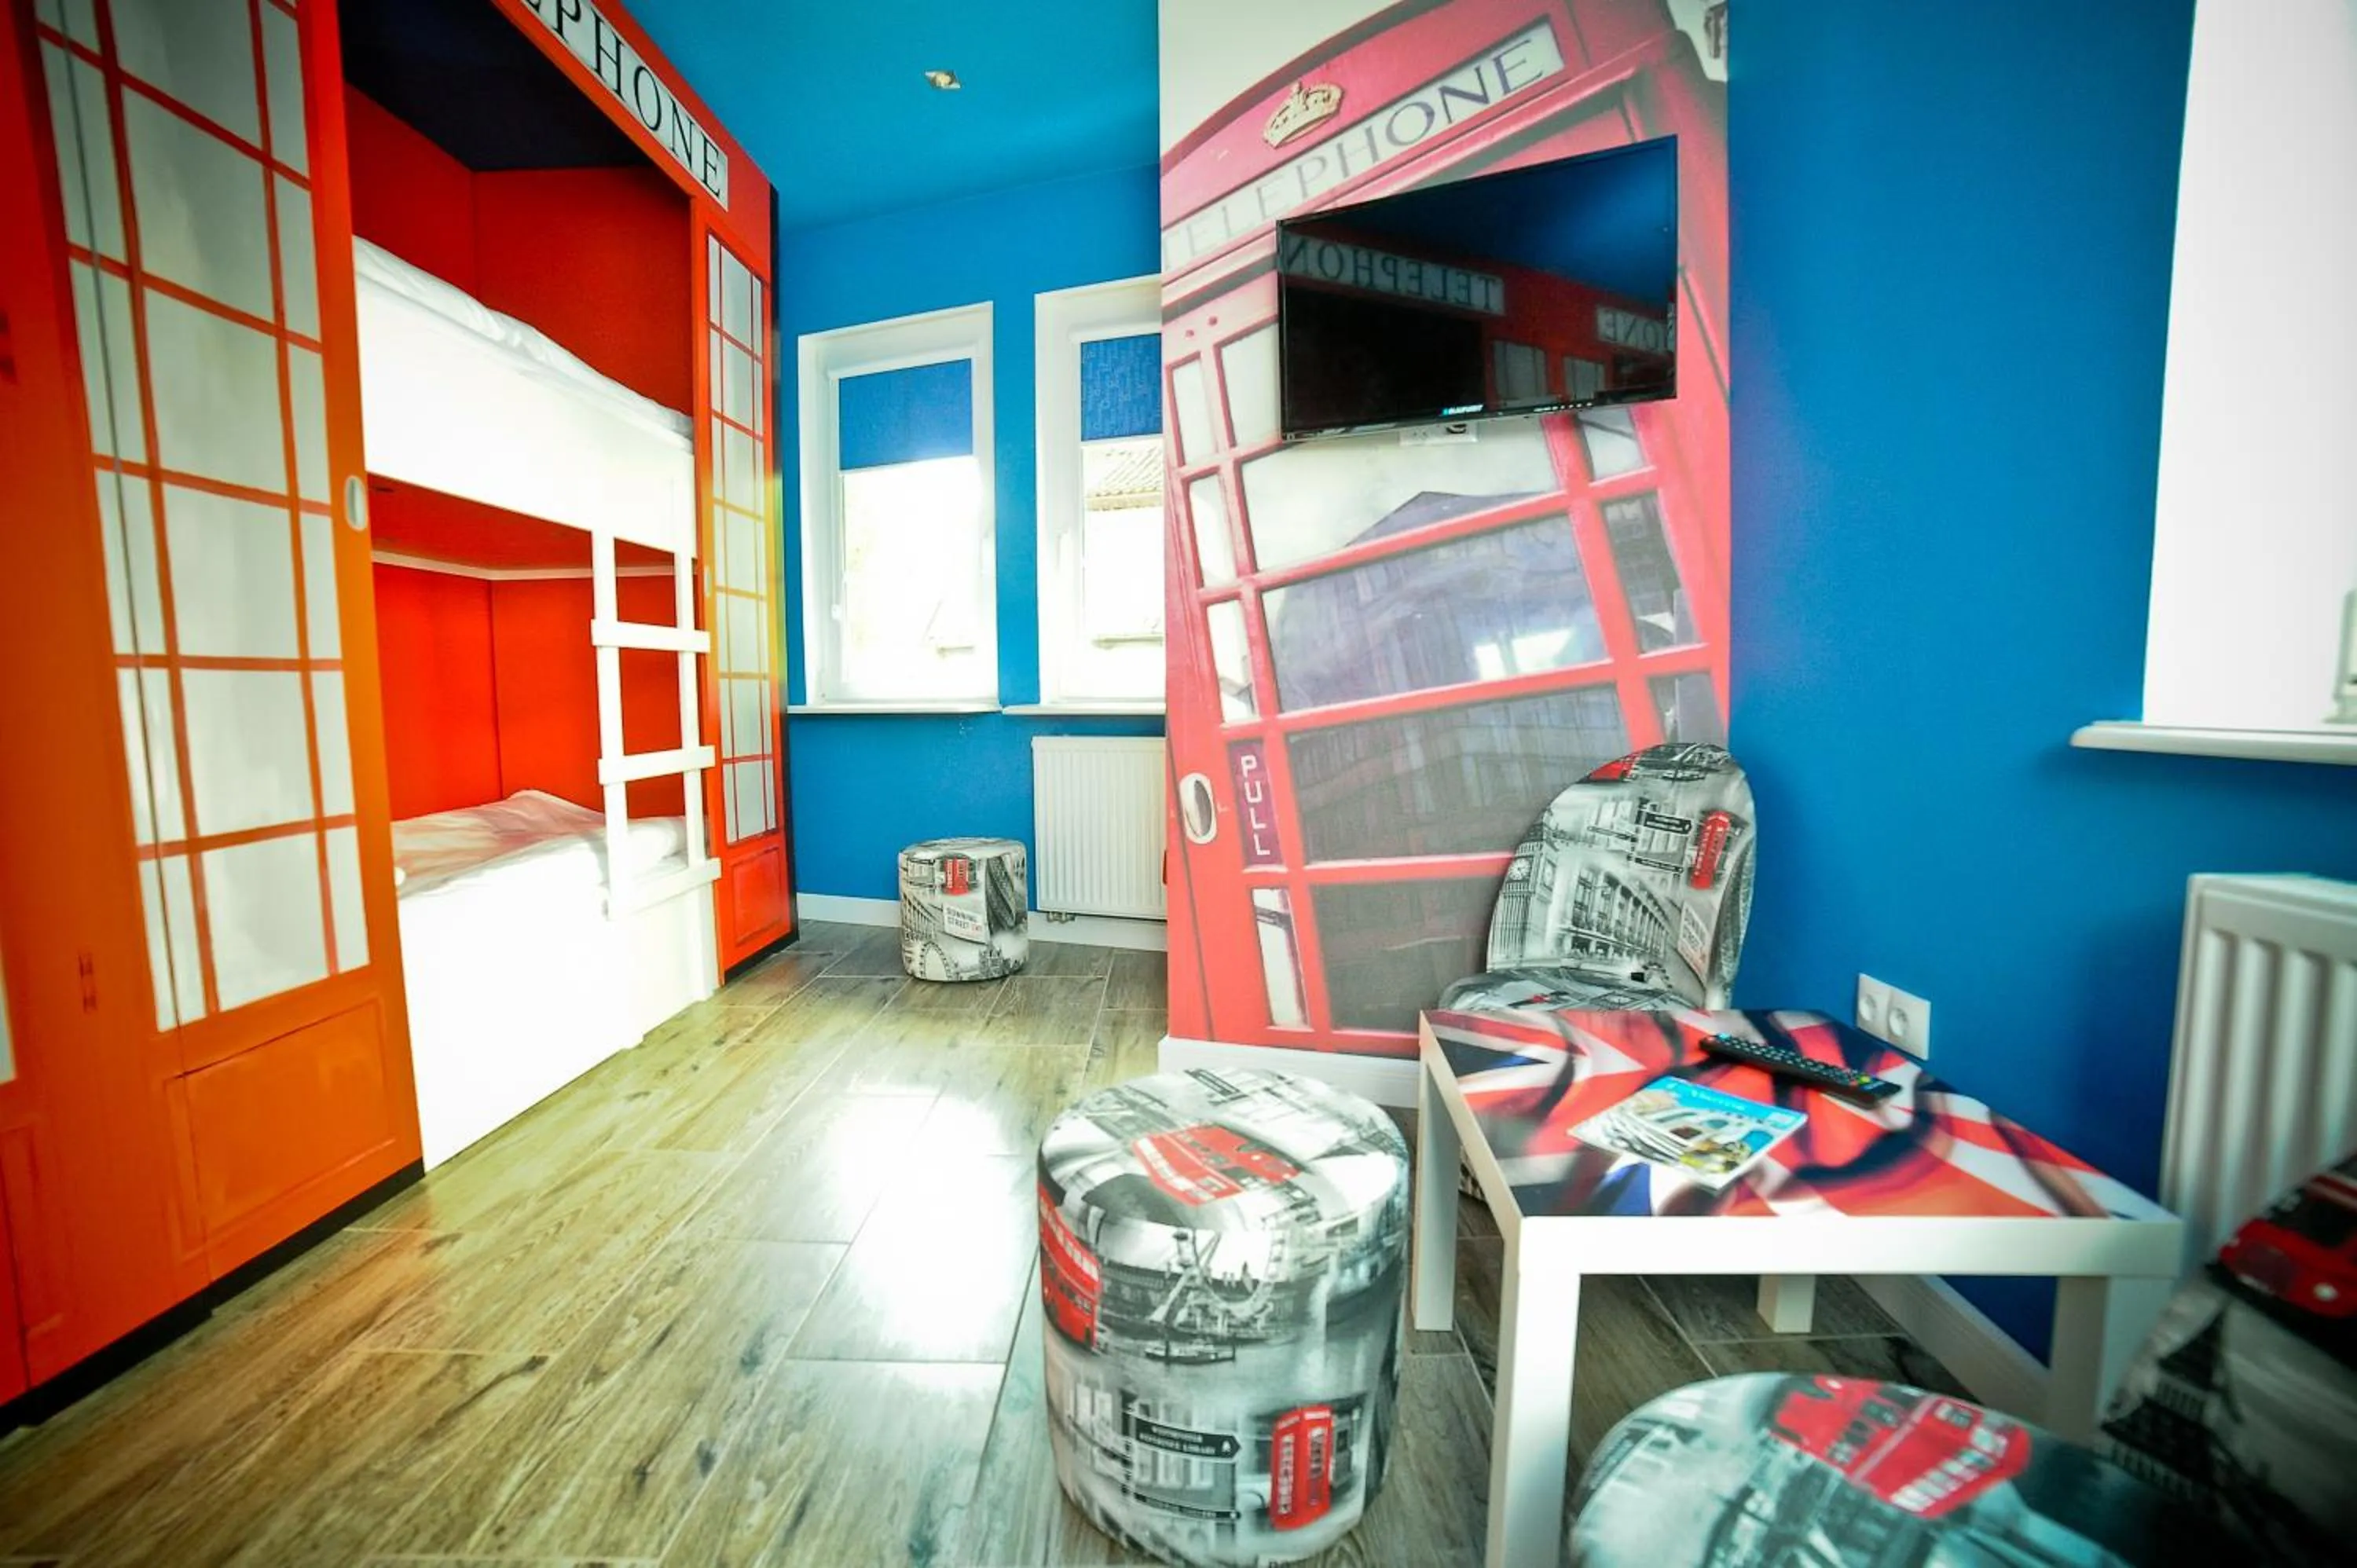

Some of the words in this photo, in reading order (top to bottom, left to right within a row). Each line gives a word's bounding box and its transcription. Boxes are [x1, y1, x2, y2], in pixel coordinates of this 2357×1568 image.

[527, 0, 721, 197] PHONE
[1162, 38, 1544, 272] TELEPHONE
[1241, 754, 1270, 855] PULL
